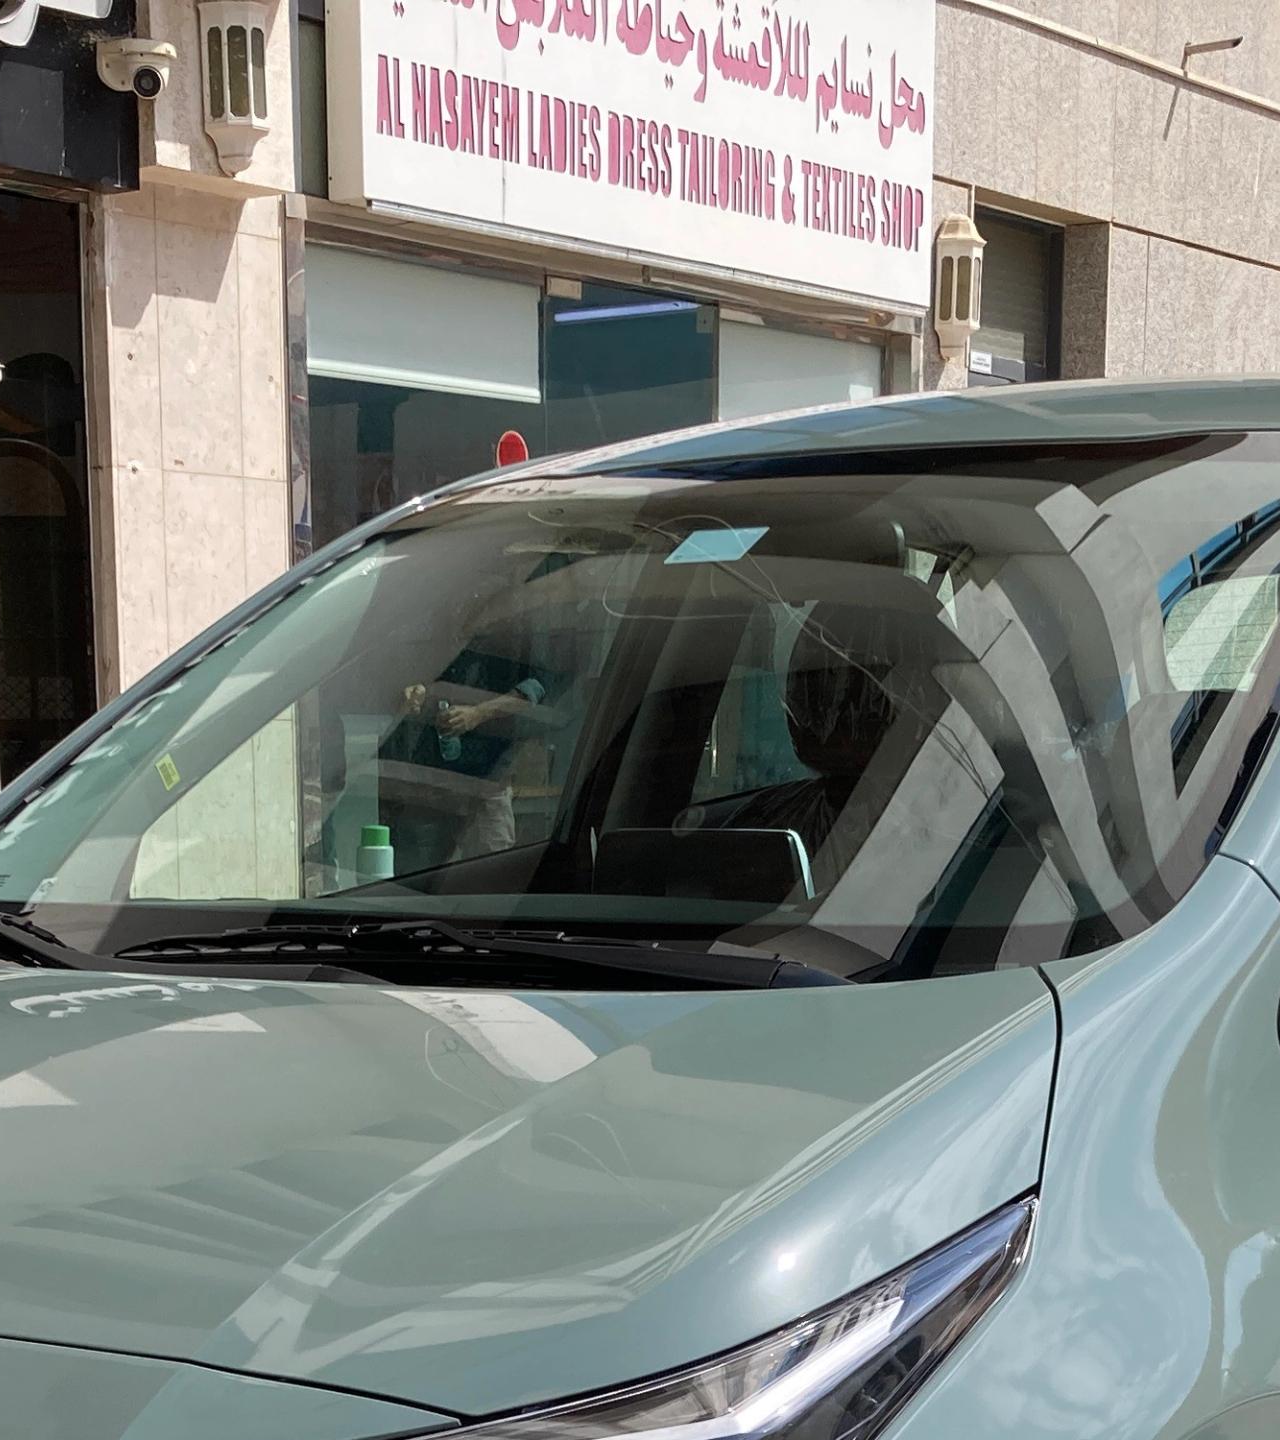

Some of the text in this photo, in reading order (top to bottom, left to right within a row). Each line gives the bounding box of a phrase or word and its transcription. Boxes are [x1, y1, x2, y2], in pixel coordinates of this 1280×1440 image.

[816, 35, 873, 133] نسايم
[878, 50, 925, 149] محل
[376, 54, 924, 252] AL NASAYEM LADIES DRESS TAILORING & TEXTILES SHOP
